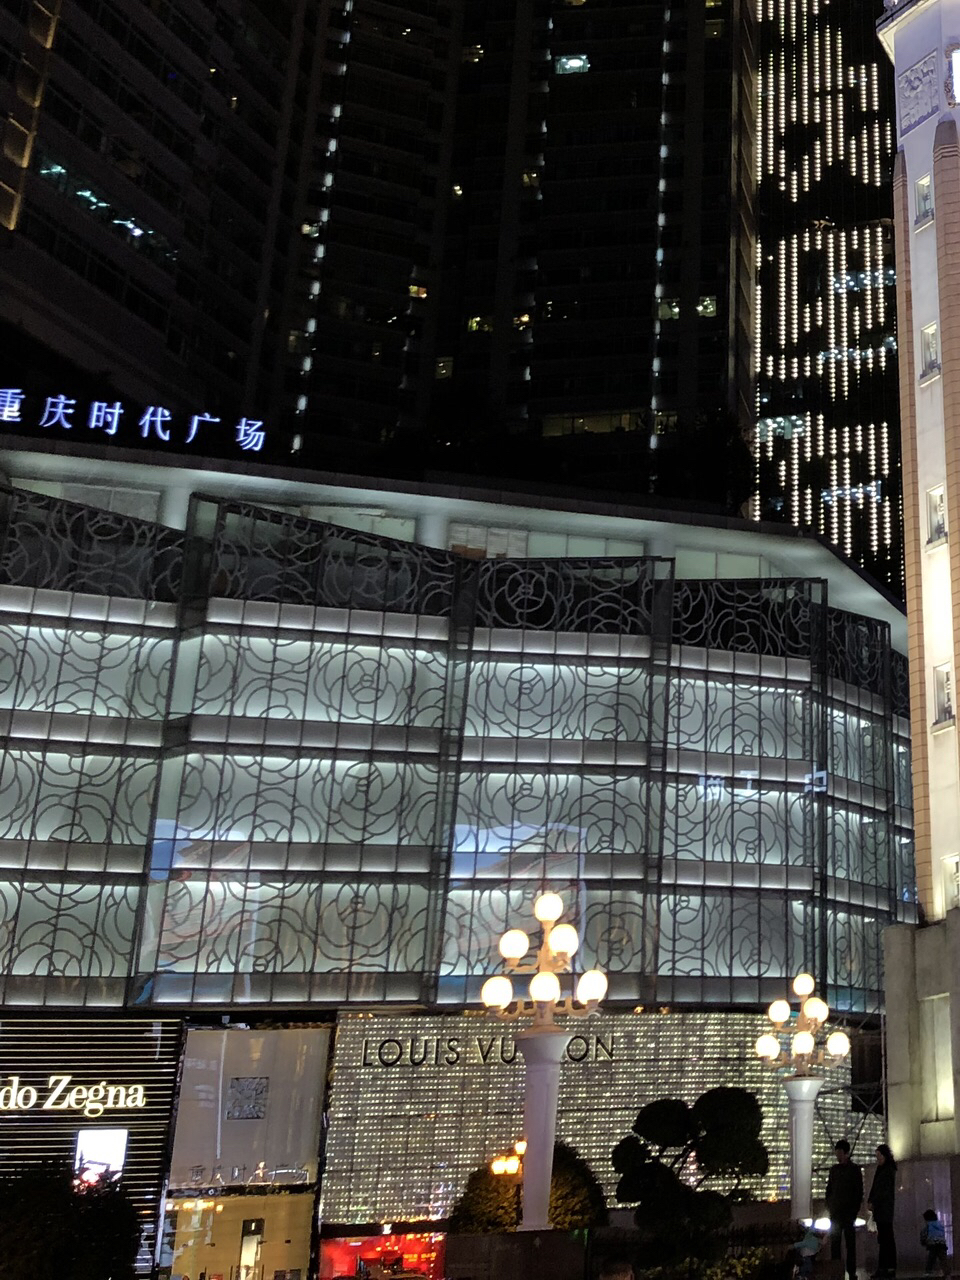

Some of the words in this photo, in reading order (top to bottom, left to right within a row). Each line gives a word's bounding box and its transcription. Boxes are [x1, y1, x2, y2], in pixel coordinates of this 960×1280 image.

[0, 388, 266, 451] 重庆时代广场
[362, 1037, 461, 1067] LOUIS
[476, 1033, 614, 1065] VUON
[0, 1076, 38, 1110] do
[42, 1075, 147, 1118] Zegna
